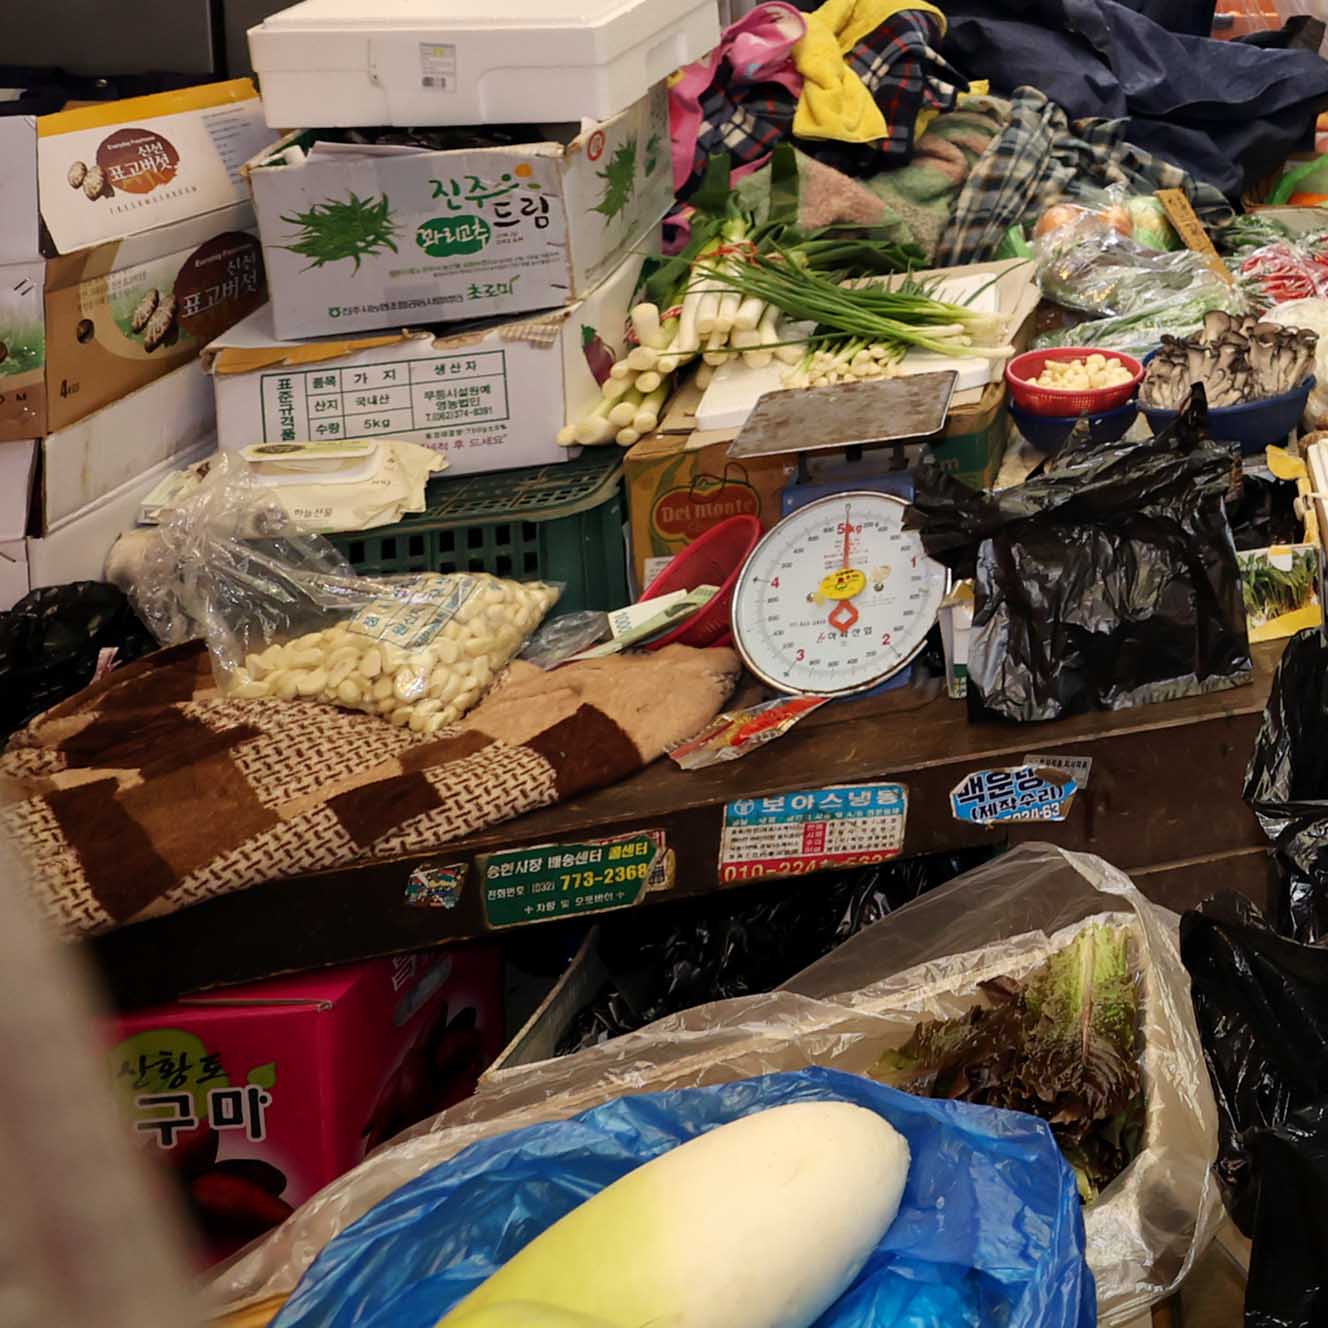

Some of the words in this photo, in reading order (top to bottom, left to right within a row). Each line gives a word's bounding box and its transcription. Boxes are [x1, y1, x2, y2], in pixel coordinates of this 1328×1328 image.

[107, 152, 173, 183] 표고버섯
[428, 175, 520, 211] 진주
[493, 196, 550, 229] 드림
[416, 217, 490, 249] 꽈리고추
[312, 375, 337, 388] 품목
[314, 399, 339, 413] 산지
[356, 394, 390, 408] 국내산
[315, 422, 340, 435] 수량
[363, 418, 390, 430] 5kg
[663, 504, 691, 522] Del
[910, 556, 918, 569] 1
[770, 576, 781, 589] 4
[881, 632, 892, 646] 2
[795, 648, 806, 661] 3
[761, 788, 899, 814] 보아스냉동
[972, 785, 1064, 821] (제작수리)
[487, 859, 543, 880] 송현시장
[548, 849, 602, 869] 배송센터
[608, 842, 648, 860] 콜센터
[487, 885, 525, 901] 전화번호
[559, 863, 649, 891] 773-2368
[135, 1085, 273, 1149] 구마
